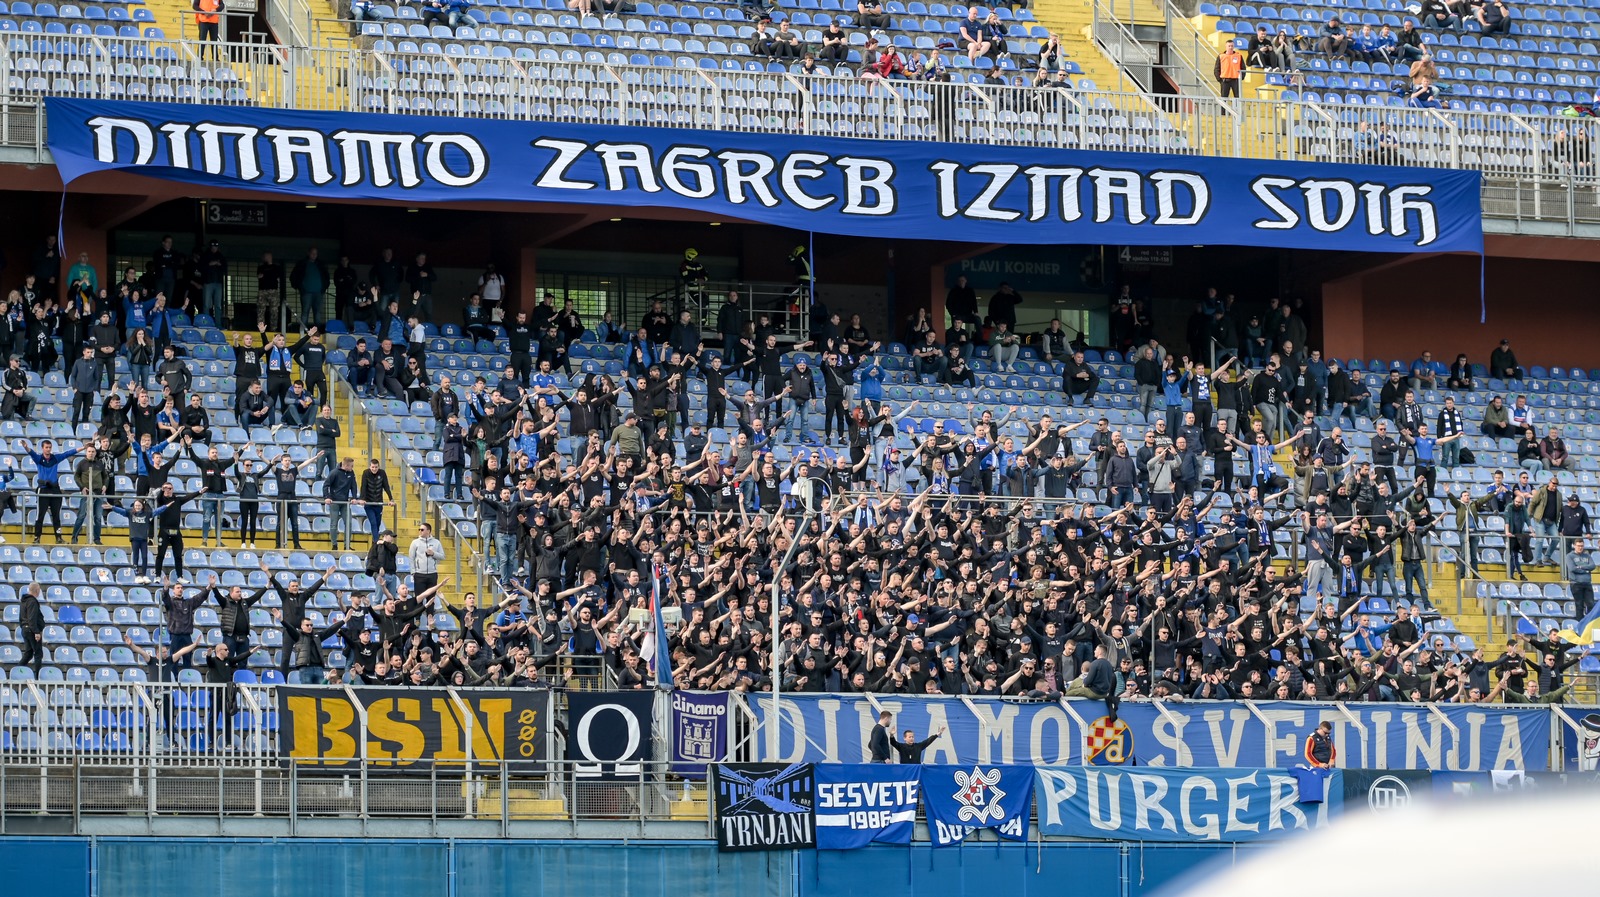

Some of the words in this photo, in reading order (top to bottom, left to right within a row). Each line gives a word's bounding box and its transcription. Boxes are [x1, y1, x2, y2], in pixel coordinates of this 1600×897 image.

[87, 115, 490, 189] DINAMO
[530, 136, 898, 217] ZAGREB
[929, 160, 1210, 227] IZNAD
[210, 205, 220, 222] 3
[961, 259, 1000, 273] PLAVI
[1004, 261, 1060, 275] KORNER
[1121, 246, 1131, 261] 4
[673, 694, 726, 717] dinamo
[287, 697, 512, 766] BSN
[757, 698, 1071, 766] DINAMO
[1149, 709, 1526, 771] SVETINJA
[818, 780, 919, 808] SESVETE
[1036, 767, 1333, 840] PURGERI
[721, 813, 813, 847] TRNJANI
[849, 811, 892, 830] 1986
